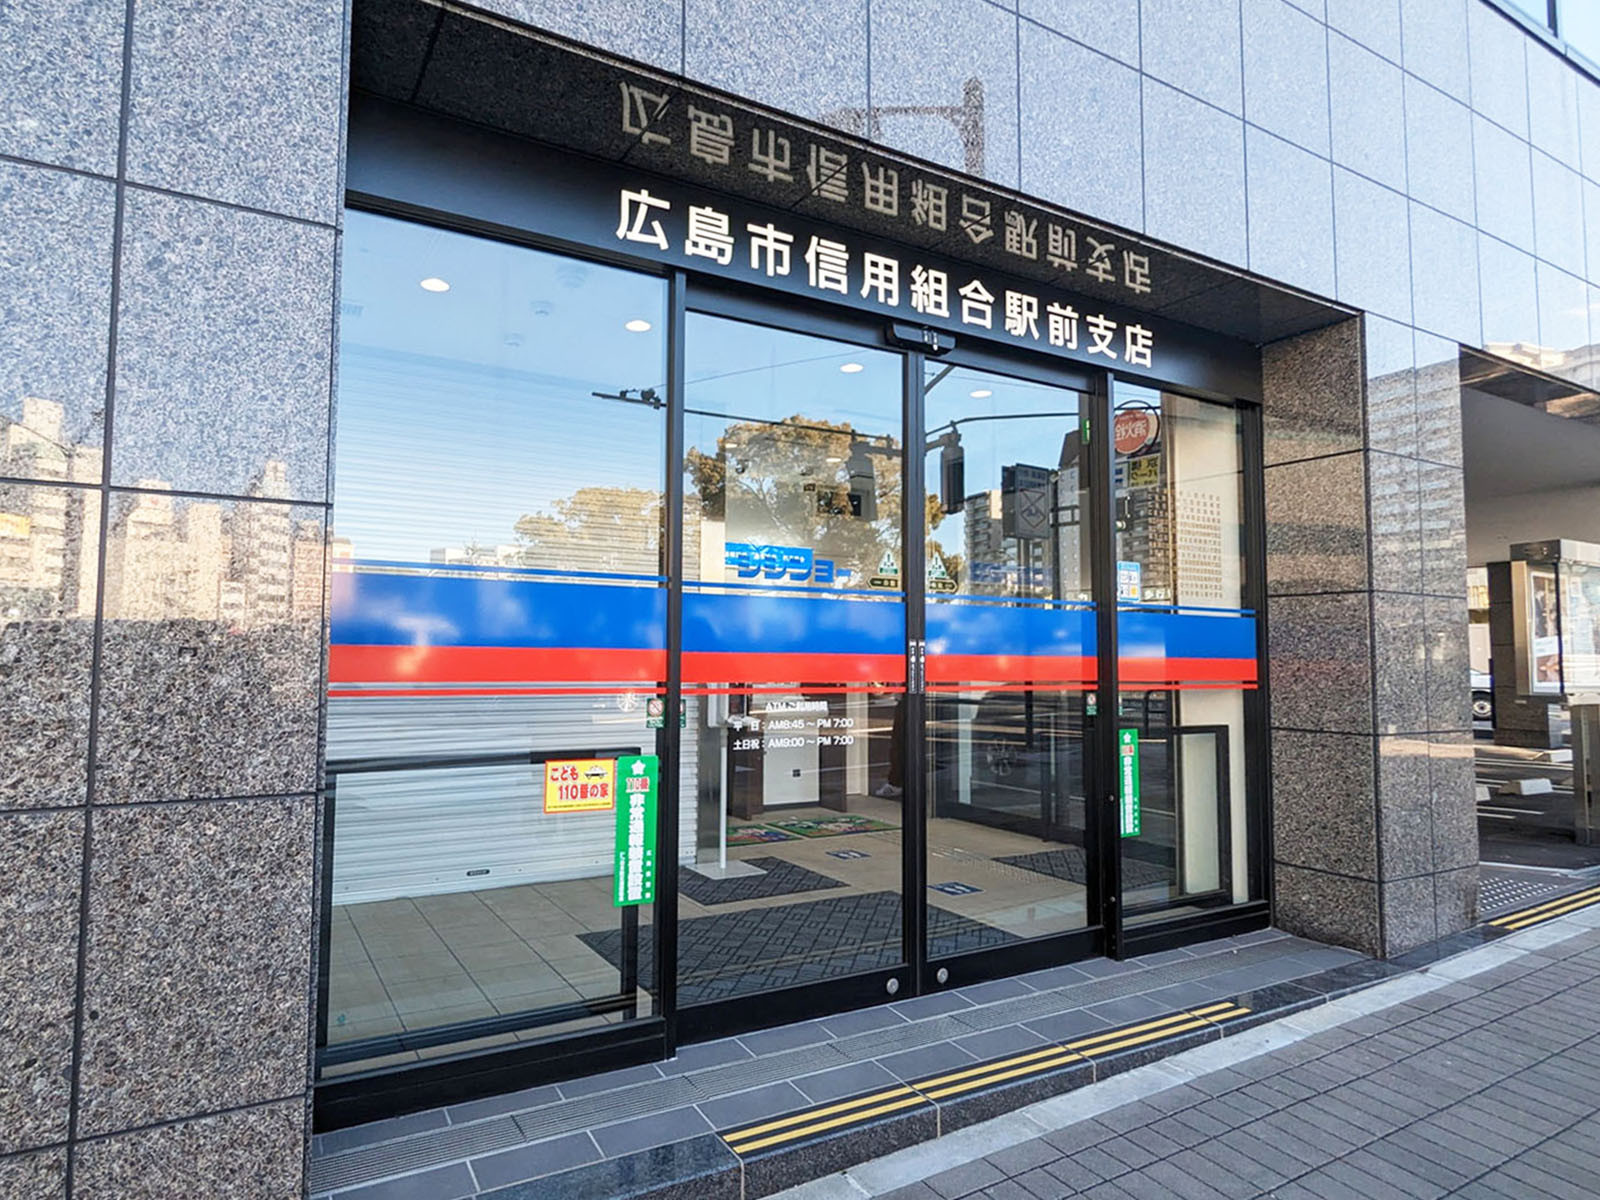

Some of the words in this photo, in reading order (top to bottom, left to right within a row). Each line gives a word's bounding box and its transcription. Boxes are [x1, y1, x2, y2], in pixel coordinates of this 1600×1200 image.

[616, 188, 1154, 369] 広島市信用組合駅前支店
[817, 719, 832, 729] PM
[833, 718, 854, 728] 7:00
[817, 737, 832, 746] PM
[833, 736, 854, 746] 7:00
[551, 766, 579, 781] こども
[558, 783, 609, 800] 110番の家
